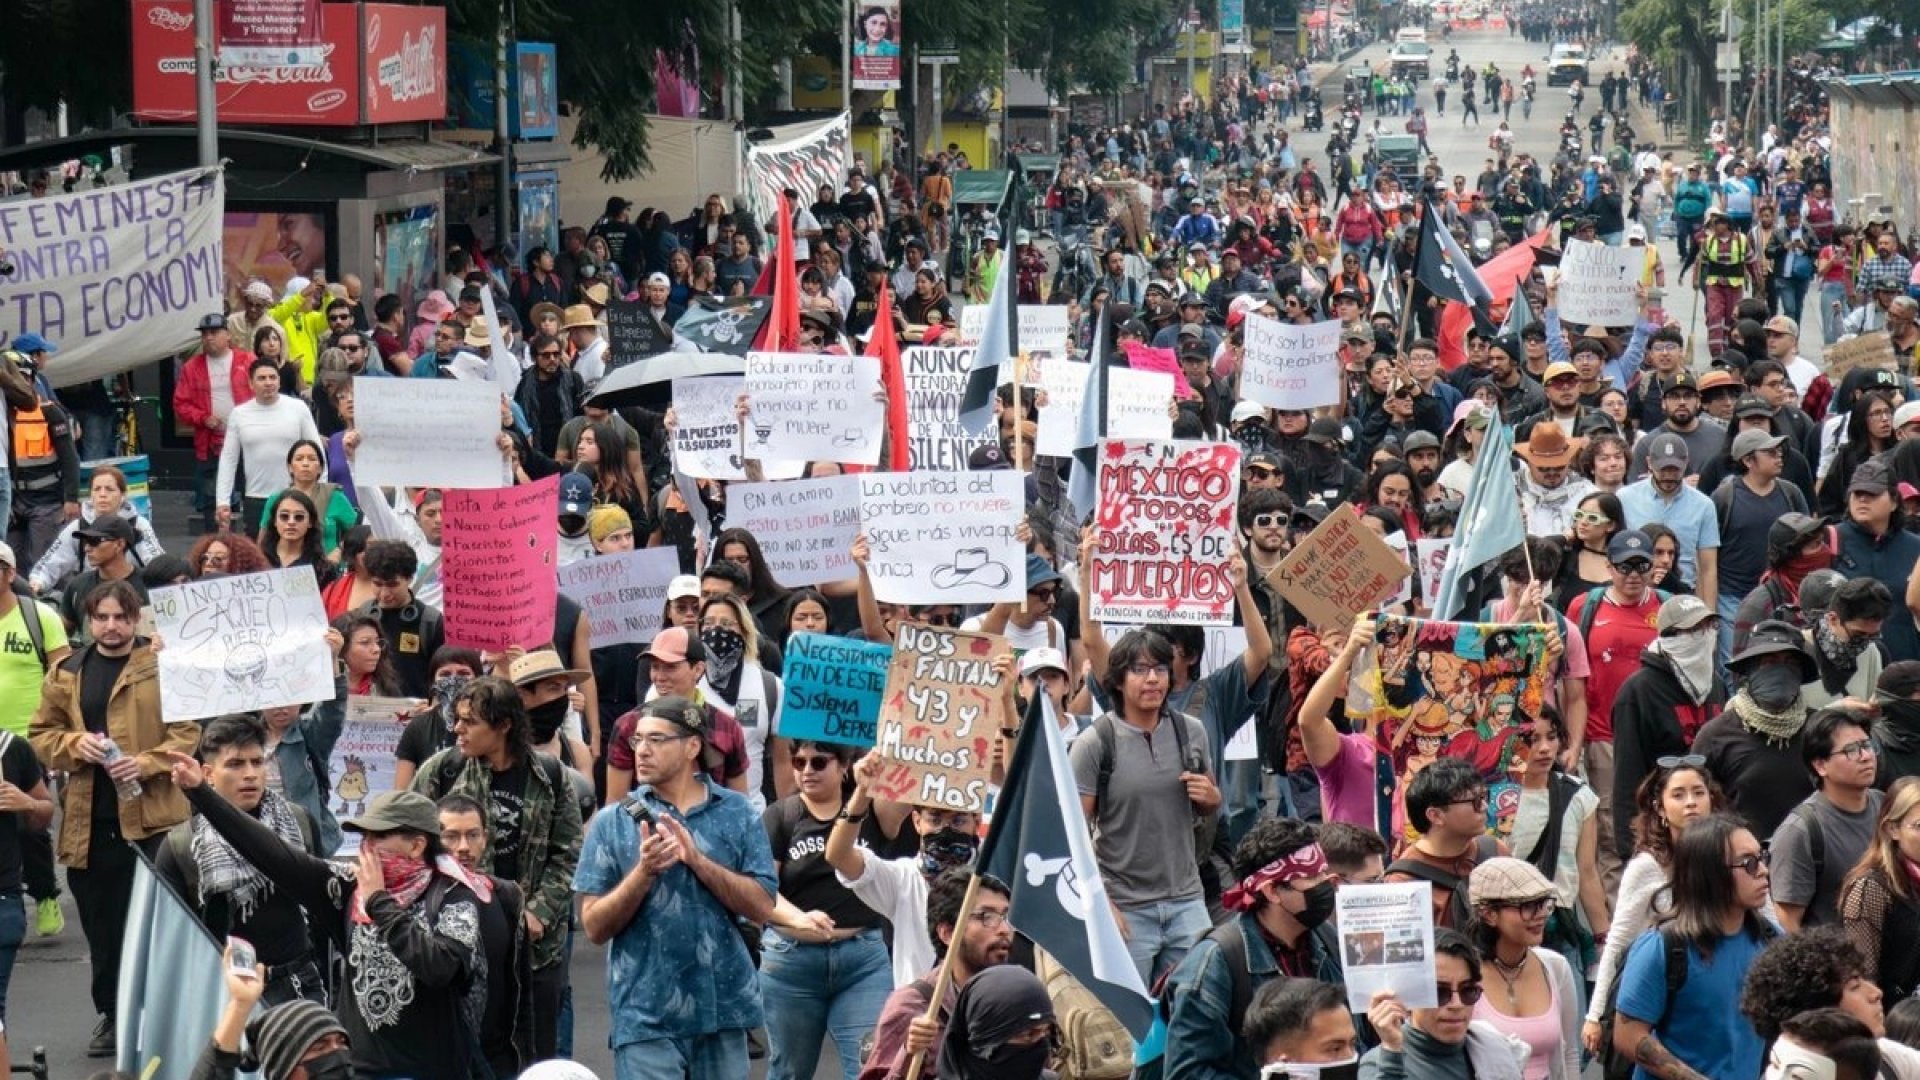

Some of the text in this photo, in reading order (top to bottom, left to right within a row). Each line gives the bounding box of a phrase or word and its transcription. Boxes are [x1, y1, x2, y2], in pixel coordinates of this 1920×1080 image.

[0, 217, 185, 286] ONTRA LA
[81, 240, 223, 338] ECONOMI
[908, 349, 977, 373] NUNC
[827, 398, 848, 412] no
[674, 422, 739, 441] IMPUESTOS
[677, 437, 732, 452] ABSURDOS
[862, 472, 995, 497] La voluntad del
[1100, 457, 1233, 503] MÉXICO
[934, 501, 954, 514] no
[959, 498, 1011, 514] muere
[1126, 499, 1213, 523] TODOS
[867, 527, 912, 554] Sigue
[958, 525, 995, 539] viva
[997, 525, 1019, 548] qu
[1098, 525, 1226, 558] DÍAS ES DE
[868, 560, 914, 579] unca
[1092, 554, 1234, 604] MUERTOS
[1328, 564, 1350, 586] NO
[180, 593, 289, 656] SAQUEO
[788, 635, 891, 671] NECESITAMOS
[898, 623, 956, 657] NOS
[789, 662, 883, 694] FIN DE ESTE
[787, 686, 861, 715] SISTEMA
[907, 683, 980, 738] 43 y
[881, 720, 970, 770] Muchos
[788, 836, 826, 861] BOSS
